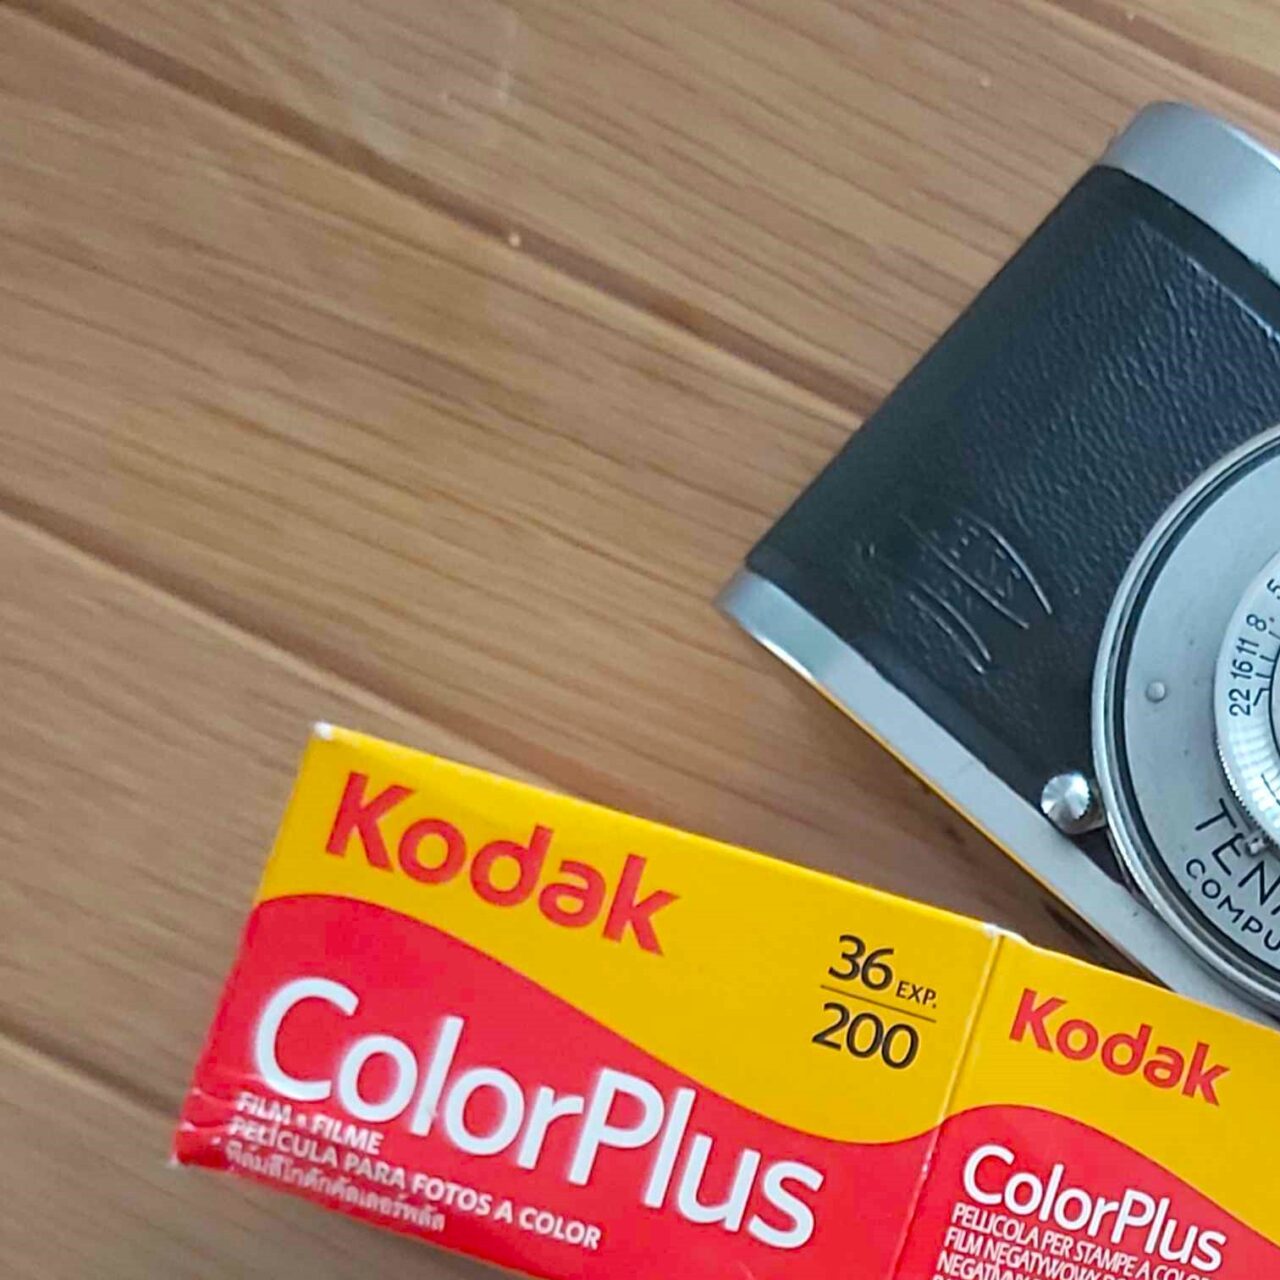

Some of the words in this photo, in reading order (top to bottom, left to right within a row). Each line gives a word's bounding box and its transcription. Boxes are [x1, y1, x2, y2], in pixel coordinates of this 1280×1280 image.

[1236, 637, 1260, 657] 11
[1246, 613, 1267, 632] 8
[1228, 688, 1251, 716] 22
[1231, 658, 1253, 680] 16
[325, 770, 681, 957] Kodak
[828, 934, 895, 991] 36
[895, 980, 938, 1009] EXP.
[811, 1002, 920, 1070] 200
[1009, 988, 1230, 1107] Kodak
[236, 1091, 293, 1126] FILM
[311, 1113, 385, 1156] FILME
[253, 977, 825, 1250] ColorPlus
[227, 1115, 338, 1168] PELÍCULA
[343, 1151, 406, 1190] PARA
[411, 1173, 493, 1217] FOTOS
[494, 1200, 514, 1225] A
[518, 1206, 602, 1251] COLOR
[962, 1145, 1227, 1272] ColorPlus
[944, 1226, 984, 1256] FILM
[952, 1202, 1040, 1249] PELLICOLA
[1041, 1231, 1074, 1259] PER
[1074, 1240, 1138, 1277] STAMPE
